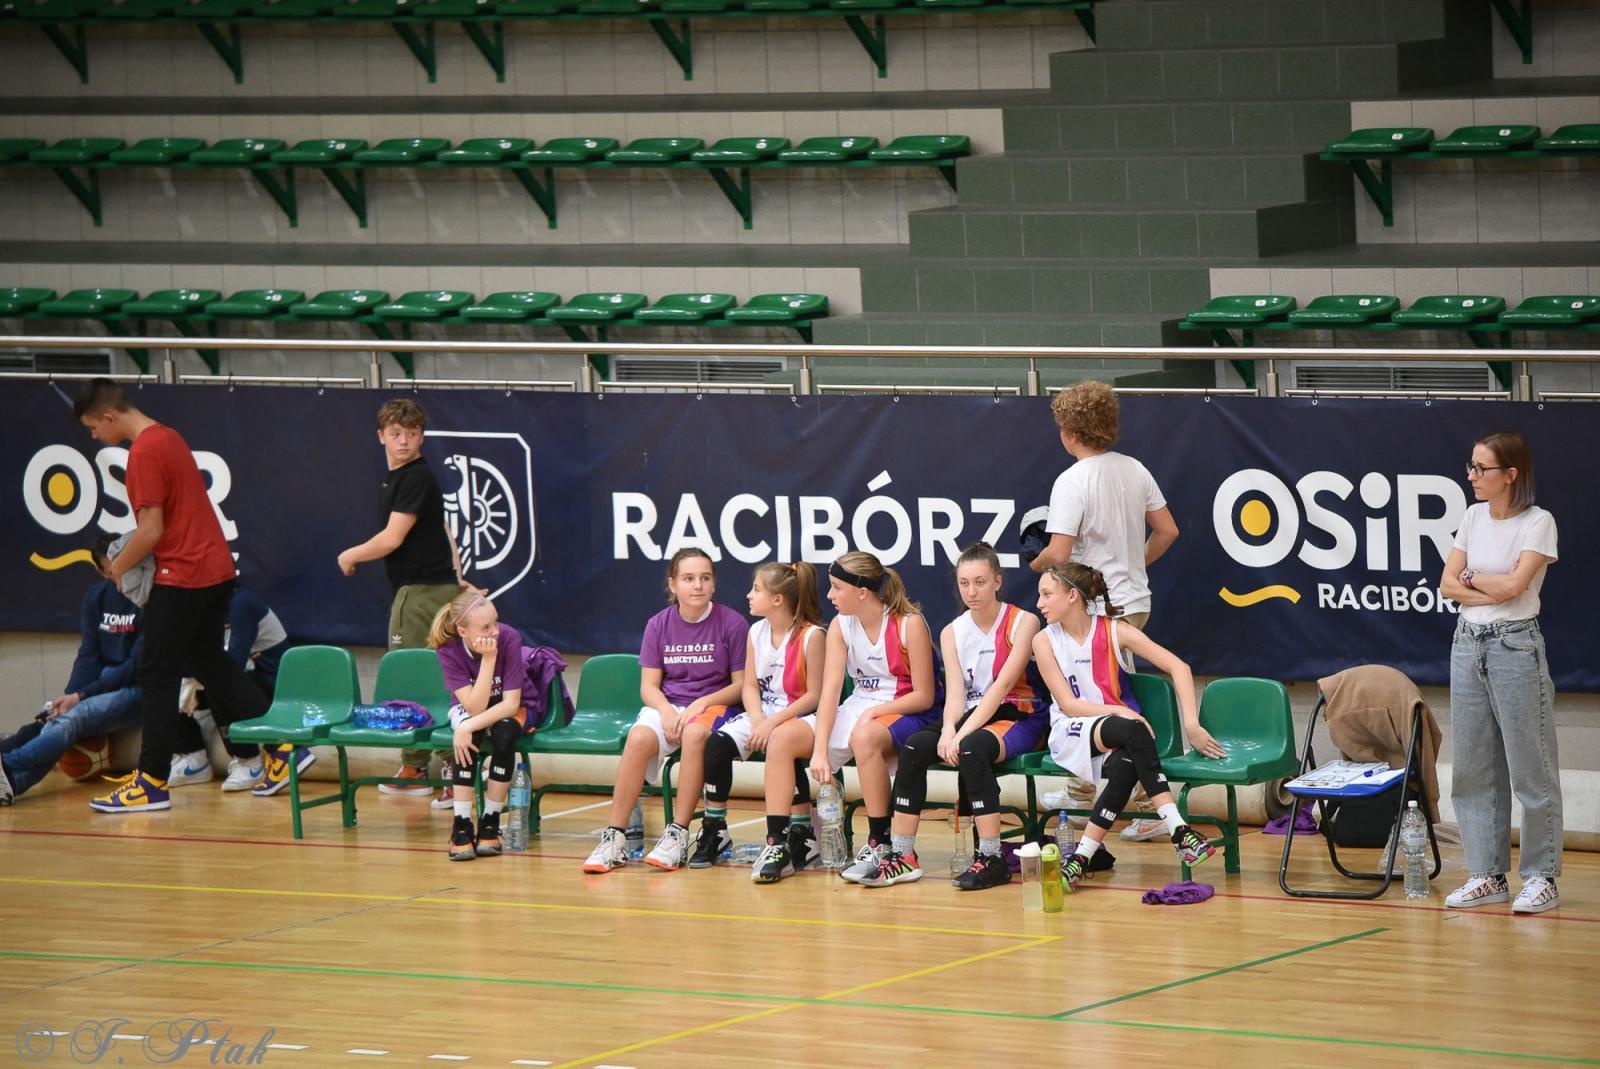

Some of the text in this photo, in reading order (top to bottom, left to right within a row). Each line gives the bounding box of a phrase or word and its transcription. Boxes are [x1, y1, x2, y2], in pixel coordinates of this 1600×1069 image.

[23, 444, 239, 541] OSR
[612, 470, 1020, 568] RACIBÓRZ
[1317, 577, 1463, 614] RACIBÓR
[663, 655, 714, 665] BASKETBALL
[664, 643, 715, 653] RACIBÓRZ
